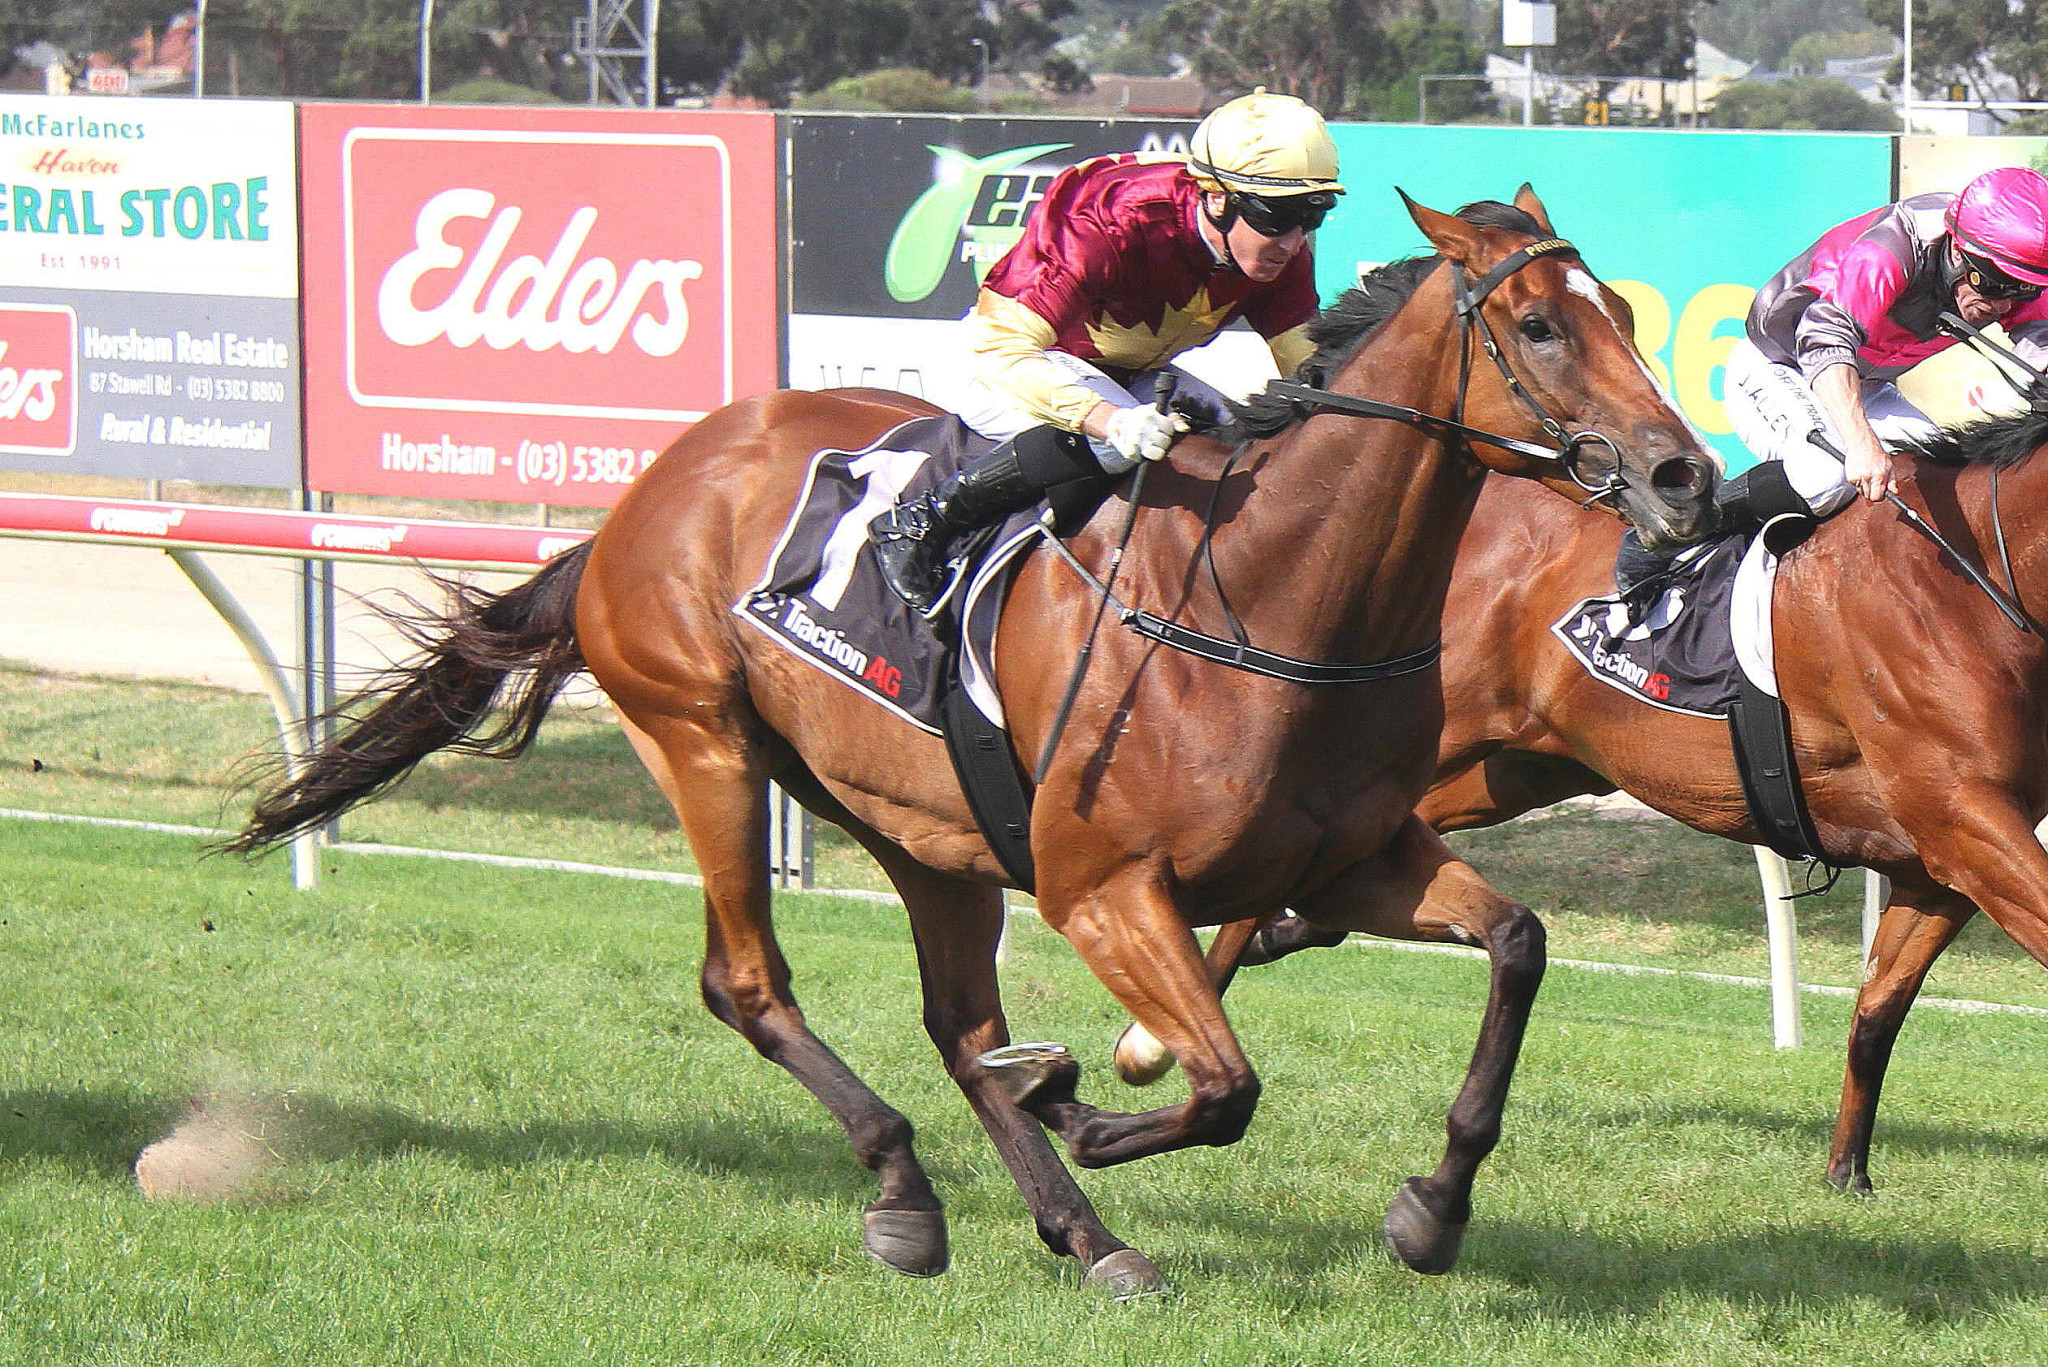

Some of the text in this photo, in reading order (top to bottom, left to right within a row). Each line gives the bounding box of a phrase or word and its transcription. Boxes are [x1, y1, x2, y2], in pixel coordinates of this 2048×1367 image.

[2, 113, 145, 139] McFarlanes
[32, 148, 119, 173] Haven
[120, 176, 269, 241] STORE
[41, 252, 121, 270] Est 1991
[1524, 239, 1573, 257] PREU
[378, 188, 703, 356] Elders
[84, 326, 289, 369] Horsham Real Estate
[0, 341, 64, 421] ers
[90, 372, 107, 394] 87
[108, 372, 154, 396] Stawell
[155, 373, 173, 397] Rd
[188, 376, 213, 402] (03)
[215, 379, 249, 401] 5382
[251, 380, 285, 403] 8800
[101, 412, 272, 451] Rural & Residential
[382, 433, 495, 475] Horsham
[518, 439, 567, 486] (03)
[571, 446, 635, 484] 5382
